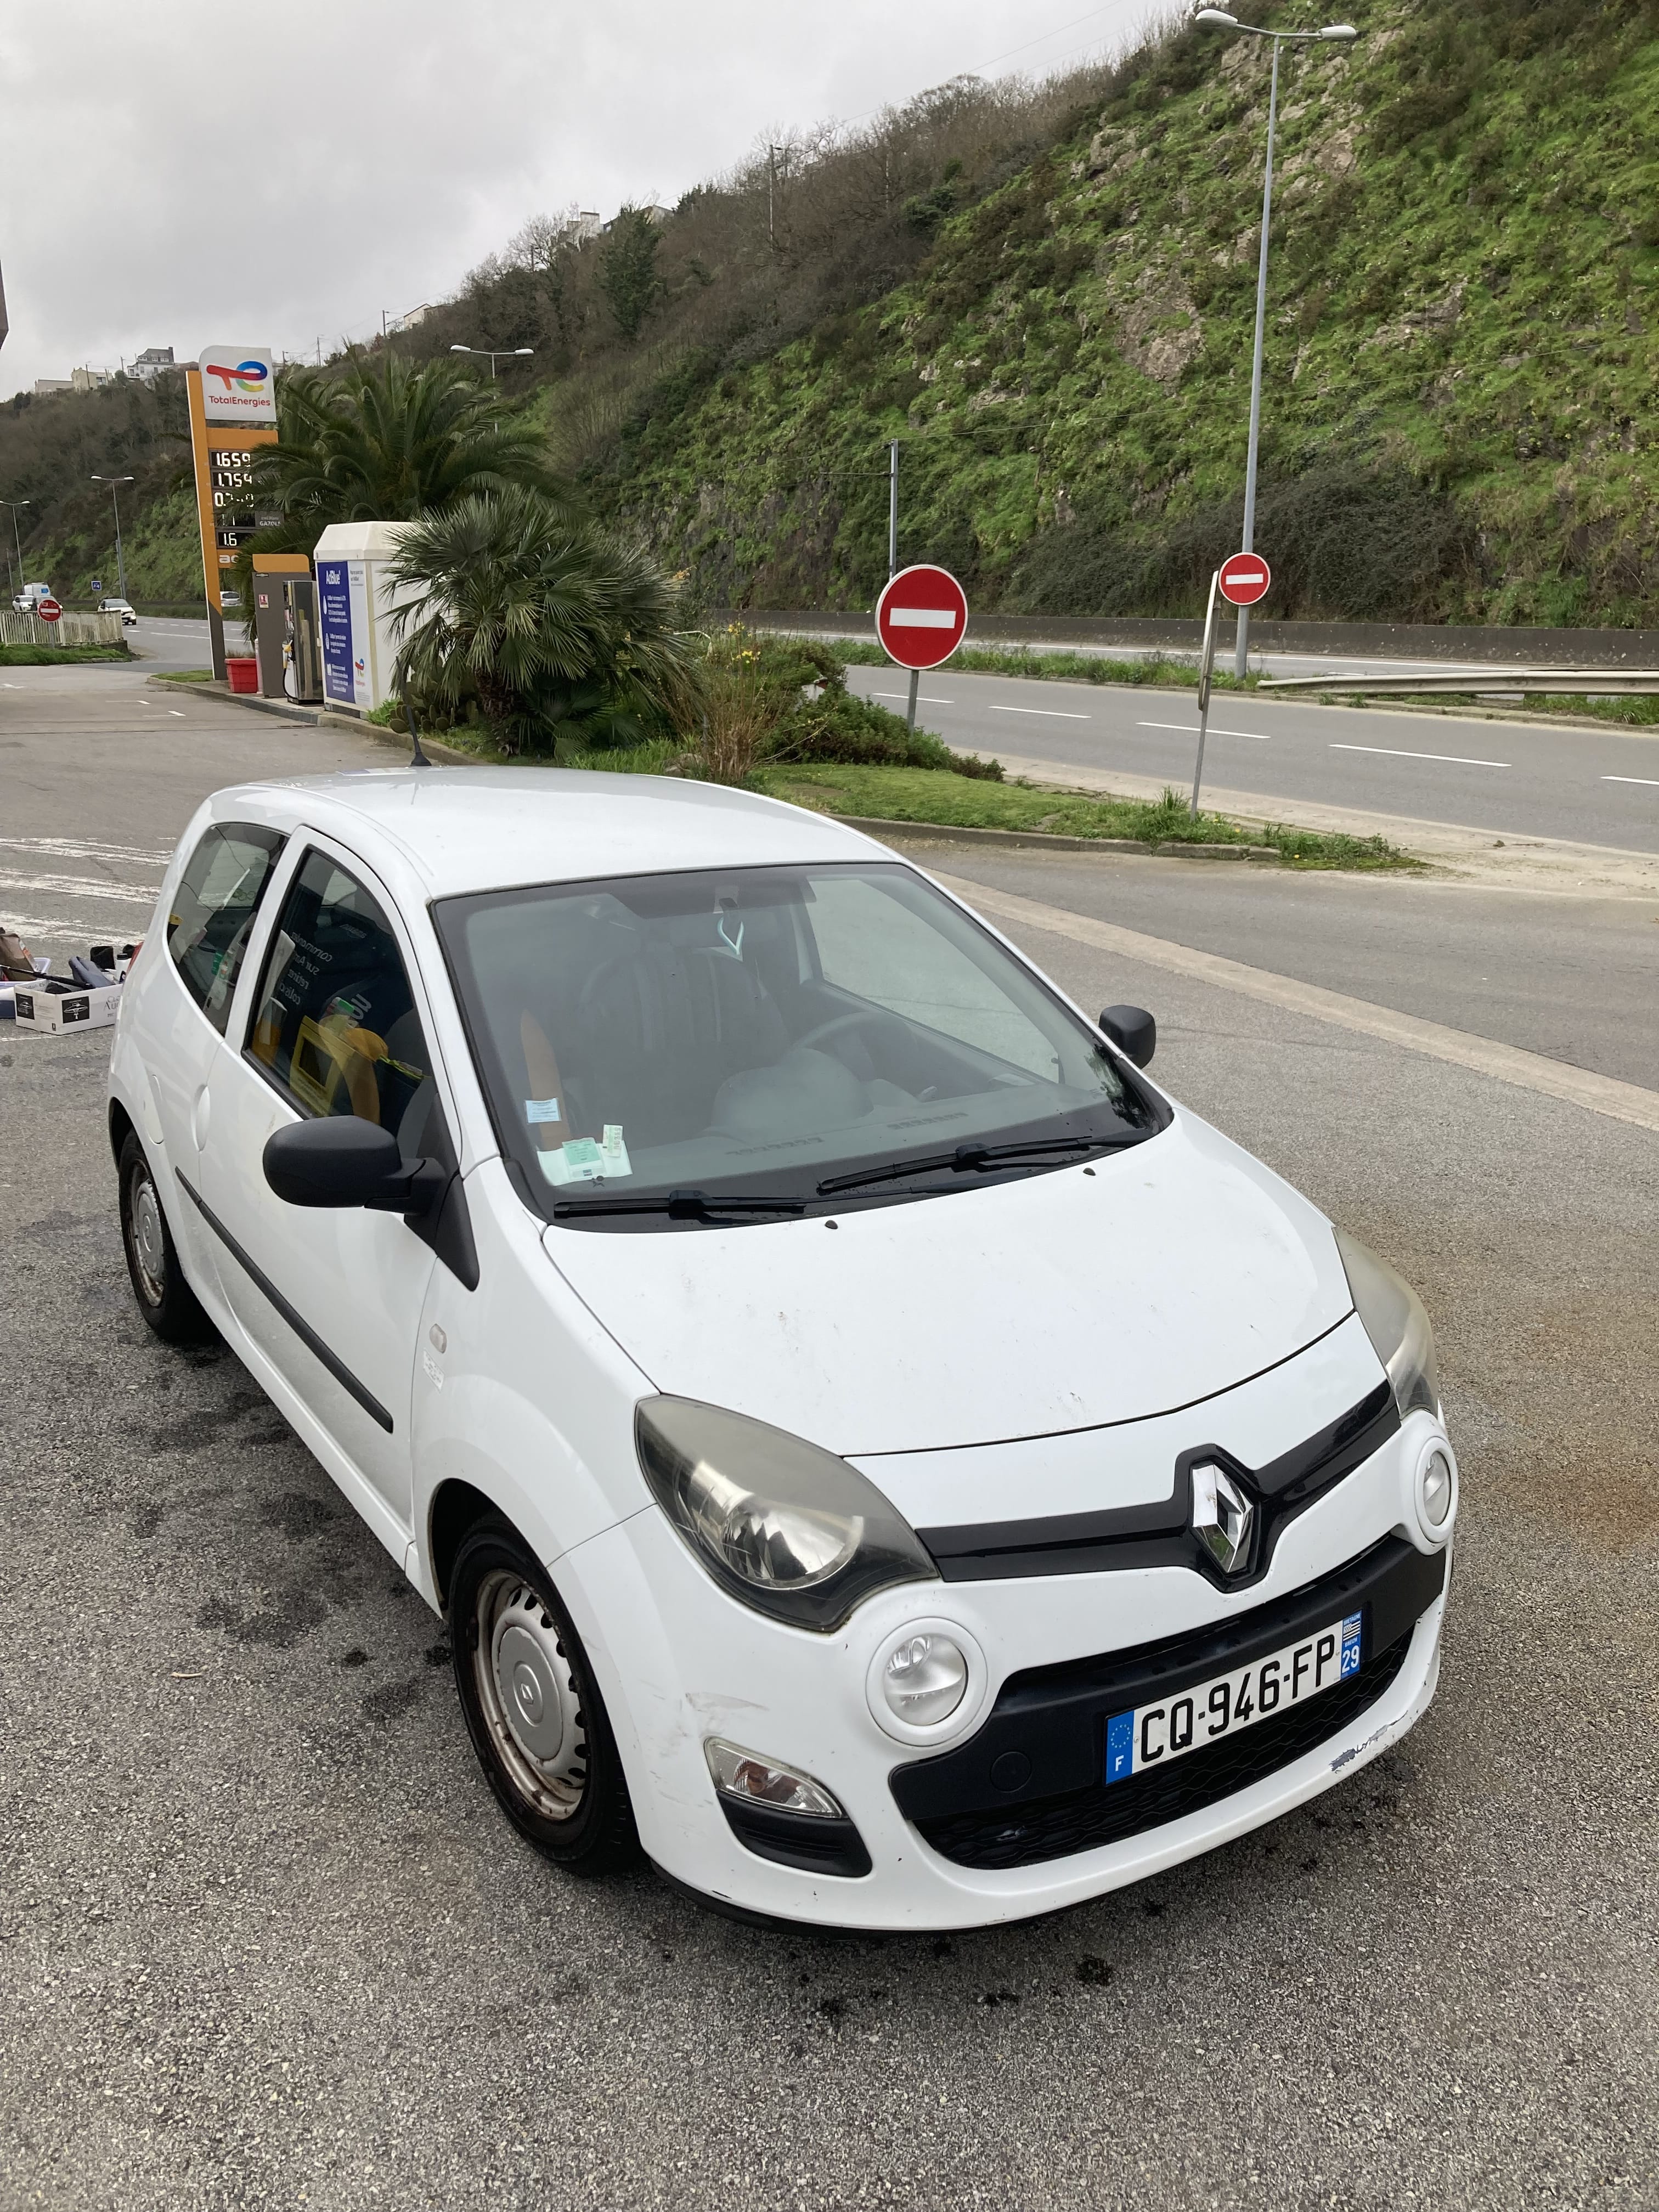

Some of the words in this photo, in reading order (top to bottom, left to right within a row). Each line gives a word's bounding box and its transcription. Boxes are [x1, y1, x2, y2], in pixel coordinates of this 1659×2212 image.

[208, 396, 270, 407] TotalEnergies
[216, 452, 251, 467] 1.659
[1341, 1645, 1360, 1674] 29
[1140, 1633, 1335, 1763] CQ-946-FP
[1114, 1754, 1124, 1771] F
